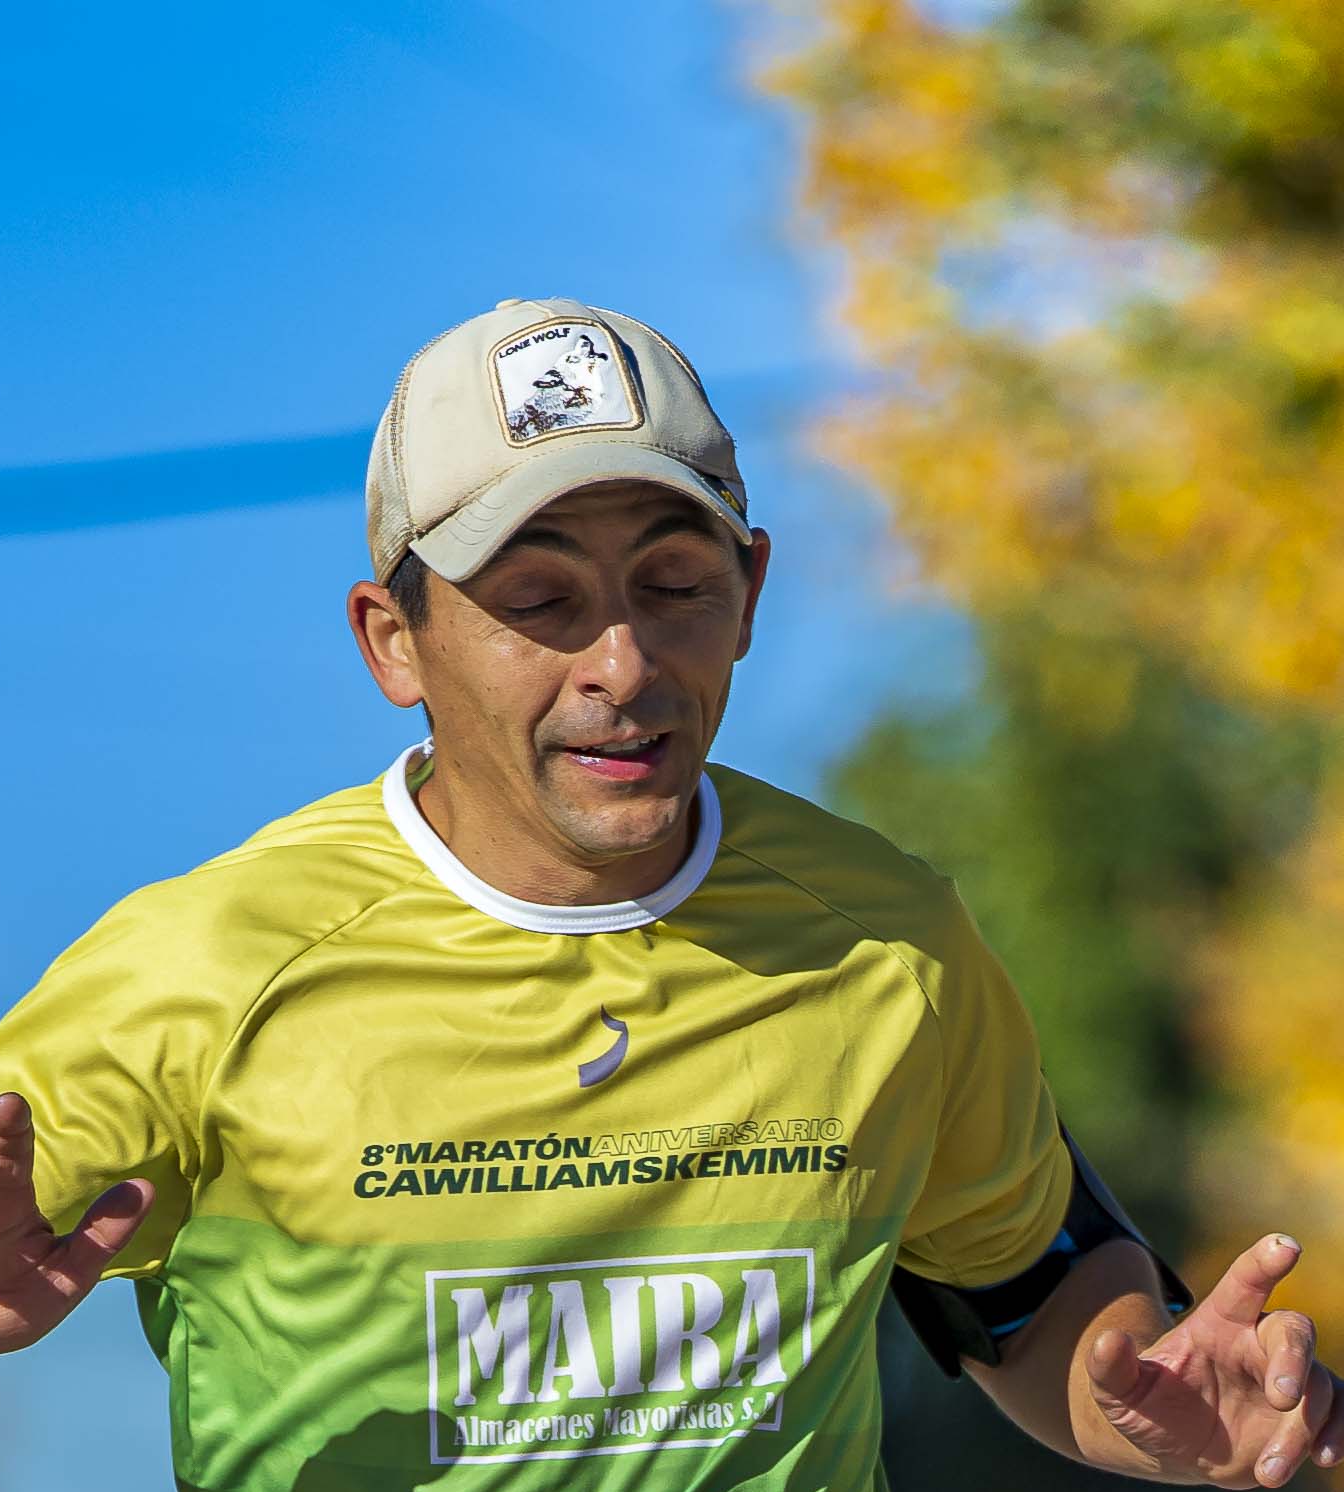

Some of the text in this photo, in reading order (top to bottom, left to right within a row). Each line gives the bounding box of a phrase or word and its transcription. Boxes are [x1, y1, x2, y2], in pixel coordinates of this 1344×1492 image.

[498, 328, 570, 358] LONE WOLF
[353, 1145, 849, 1198] CAWILLIAMSKEMMIS
[451, 1269, 788, 1406] MAIRA
[454, 1413, 595, 1446] Almacenes
[603, 1400, 735, 1437] Mayoristas
